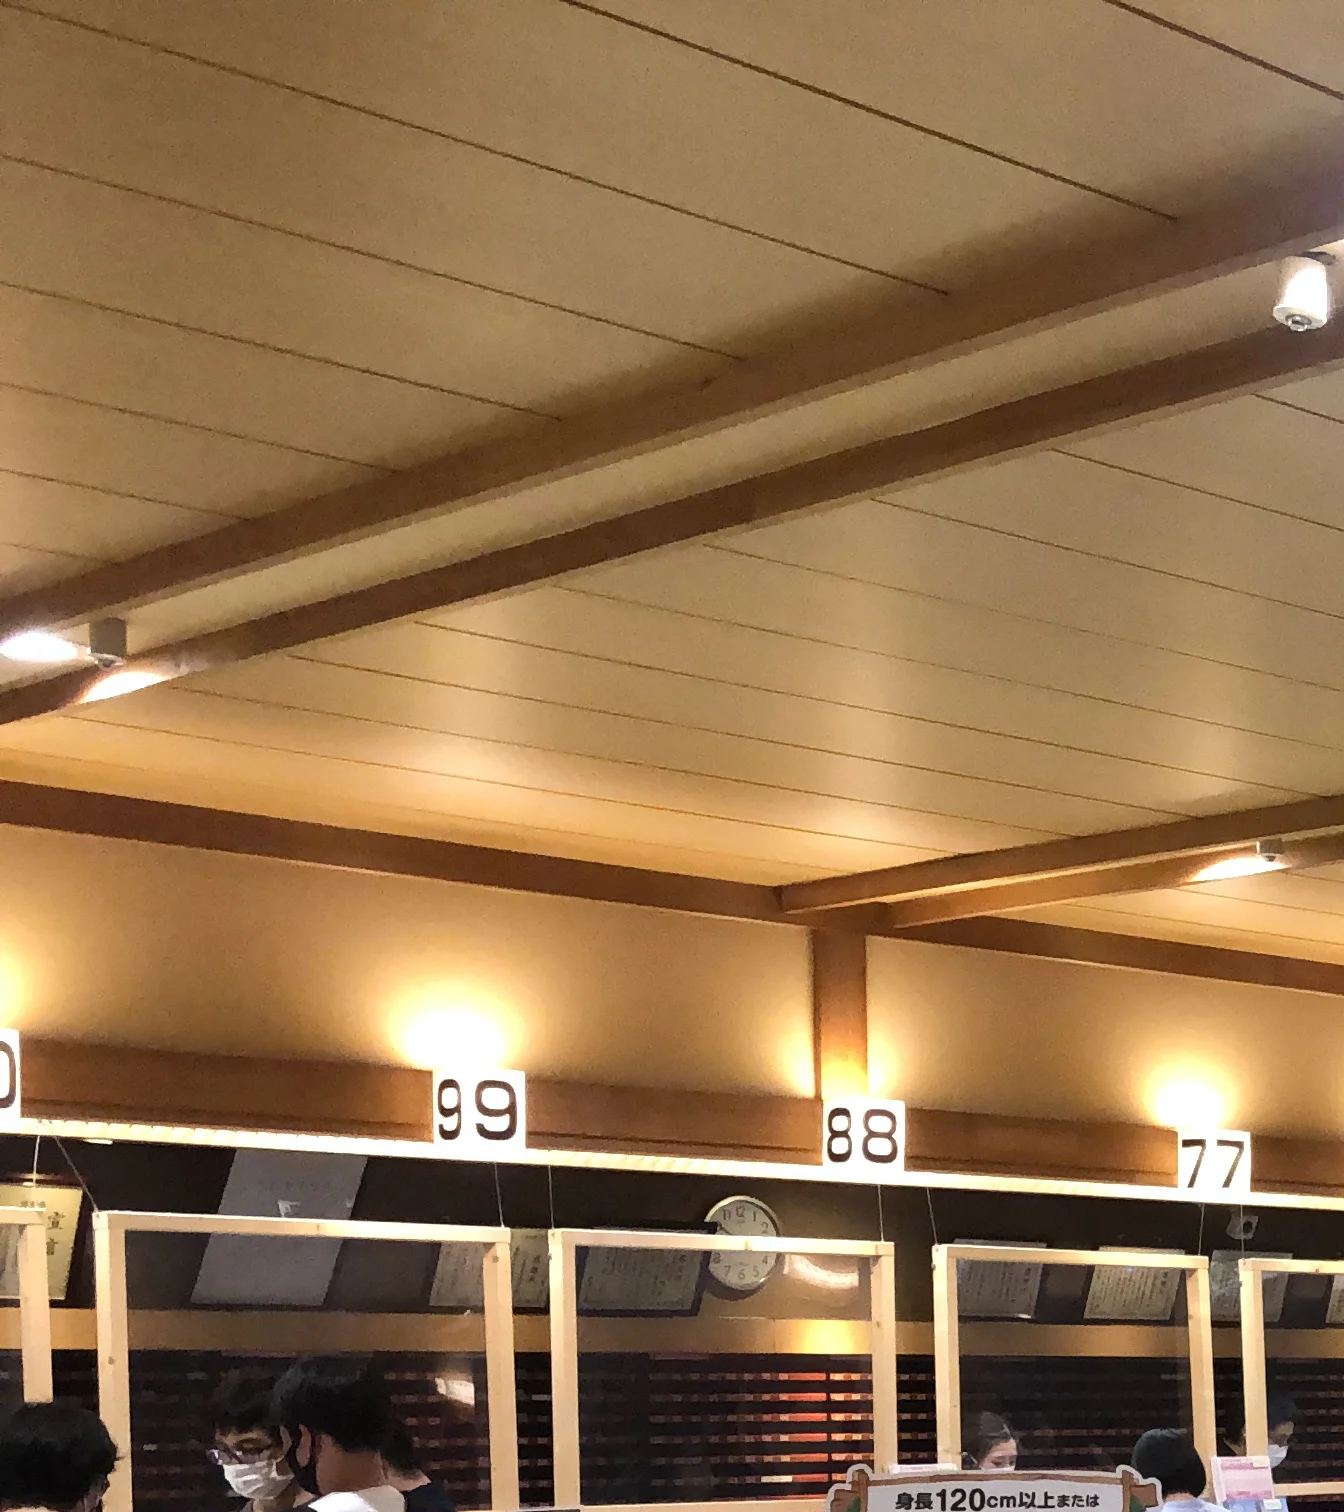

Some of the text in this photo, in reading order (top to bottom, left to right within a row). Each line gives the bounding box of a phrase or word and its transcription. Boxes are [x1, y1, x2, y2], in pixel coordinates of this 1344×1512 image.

[895, 1488, 1100, 1512] 身長120cm以上または
